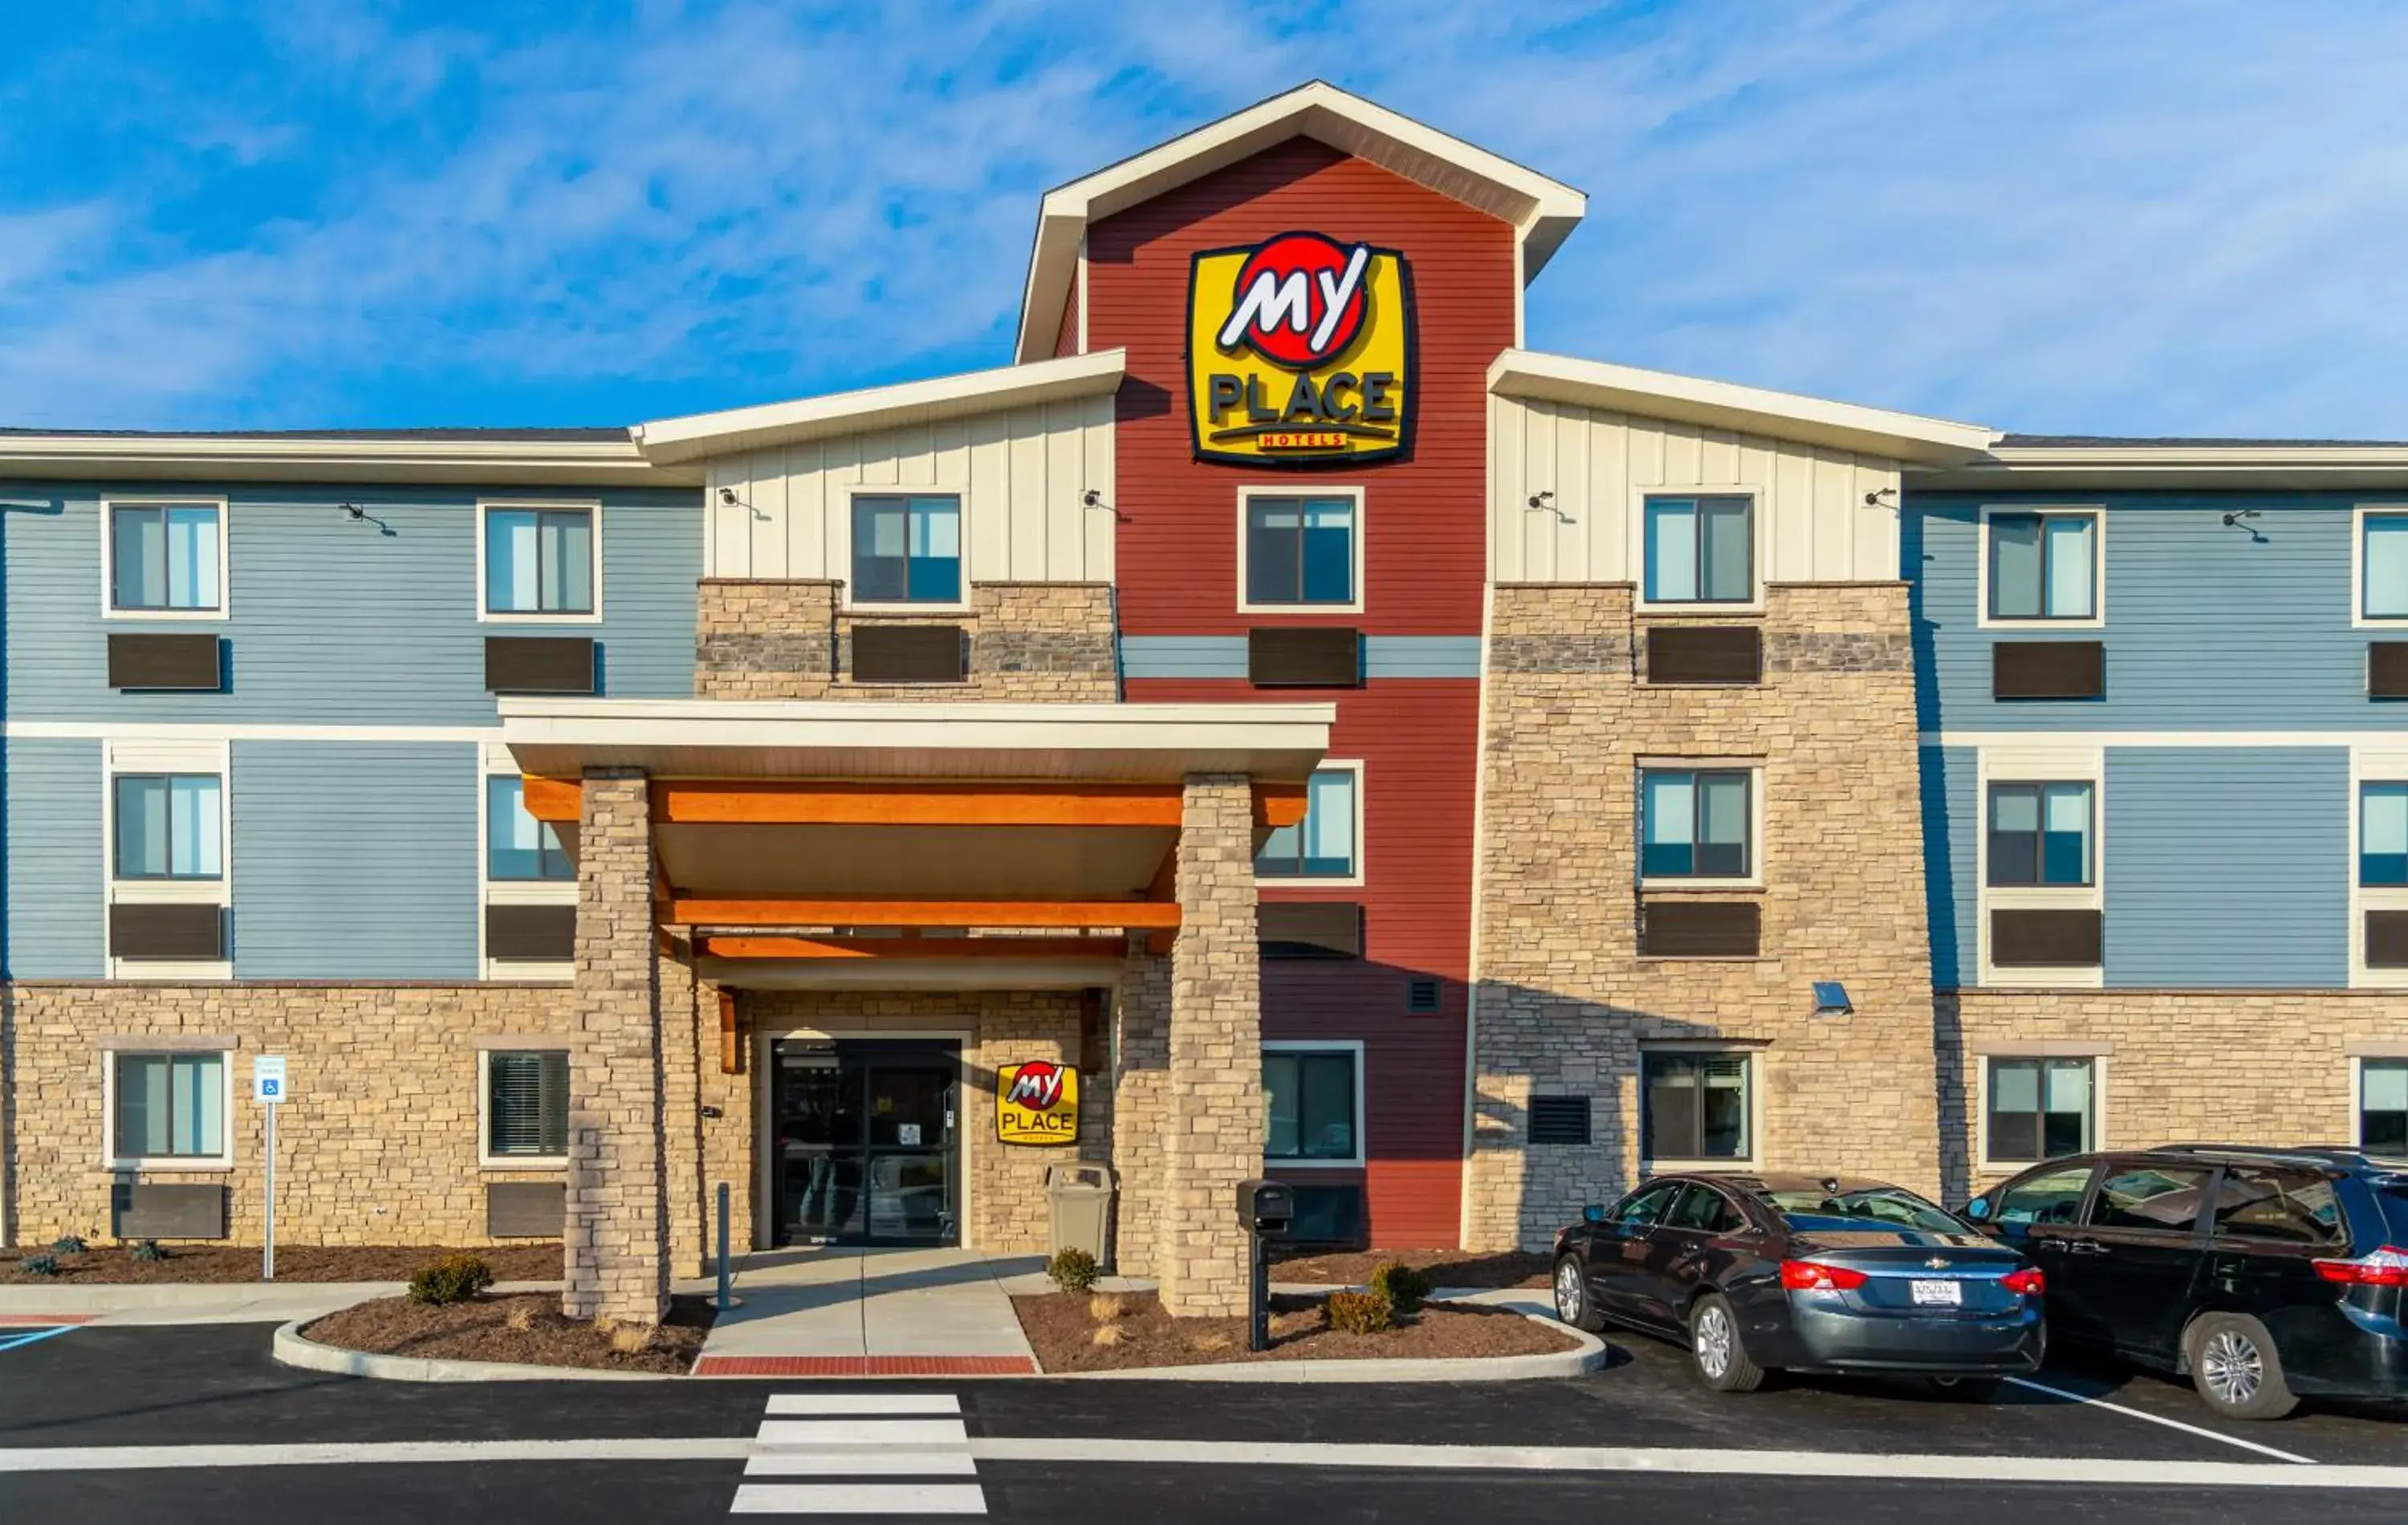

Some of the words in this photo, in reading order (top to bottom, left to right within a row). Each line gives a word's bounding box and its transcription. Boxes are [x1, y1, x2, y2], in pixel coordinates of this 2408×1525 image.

[1208, 371, 1396, 424] PLACE
[1263, 434, 1343, 446] HOTELS
[1002, 1112, 1073, 1130] PLACE
